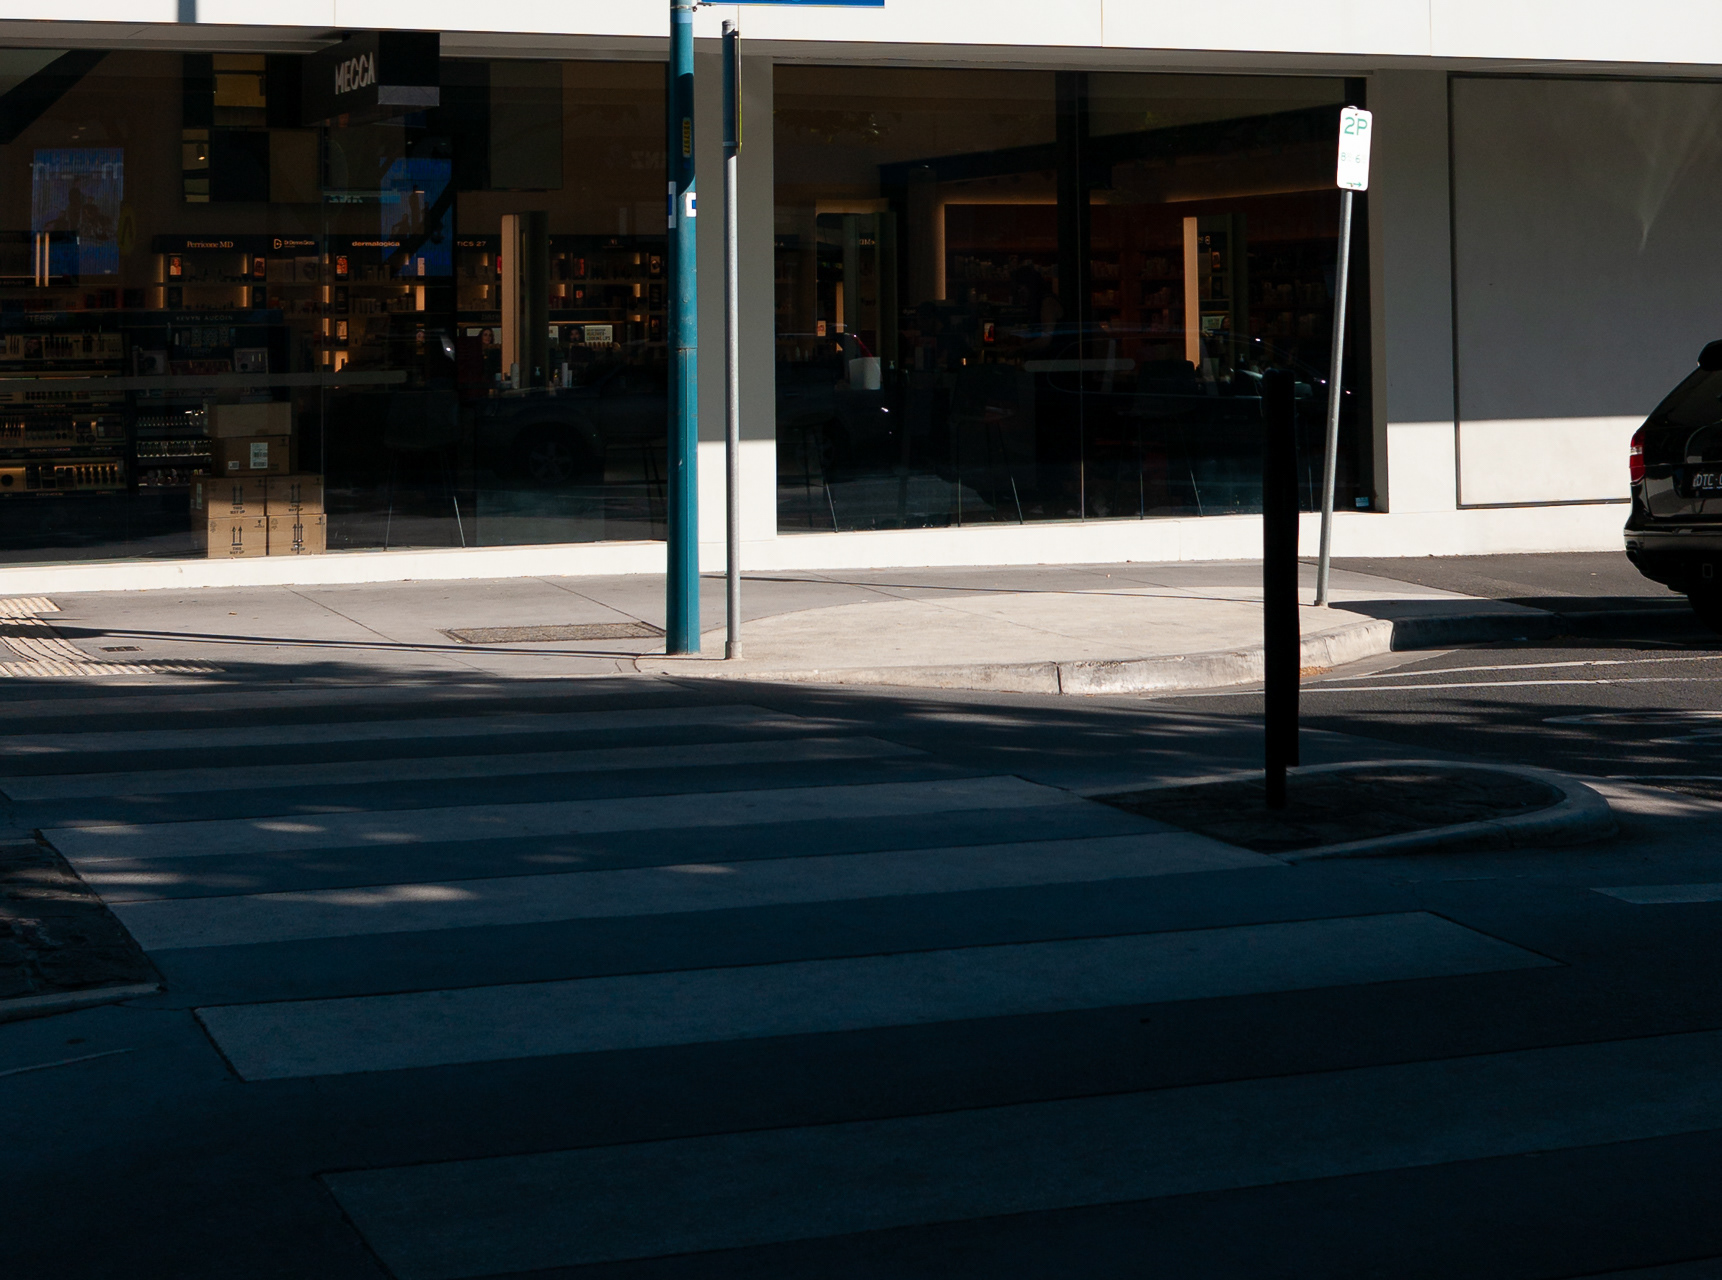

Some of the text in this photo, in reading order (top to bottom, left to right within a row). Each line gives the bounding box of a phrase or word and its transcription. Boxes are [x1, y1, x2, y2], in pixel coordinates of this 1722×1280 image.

[335, 51, 376, 95] MECCA
[1344, 116, 1368, 135] 2P
[351, 240, 401, 248] dermalogica
